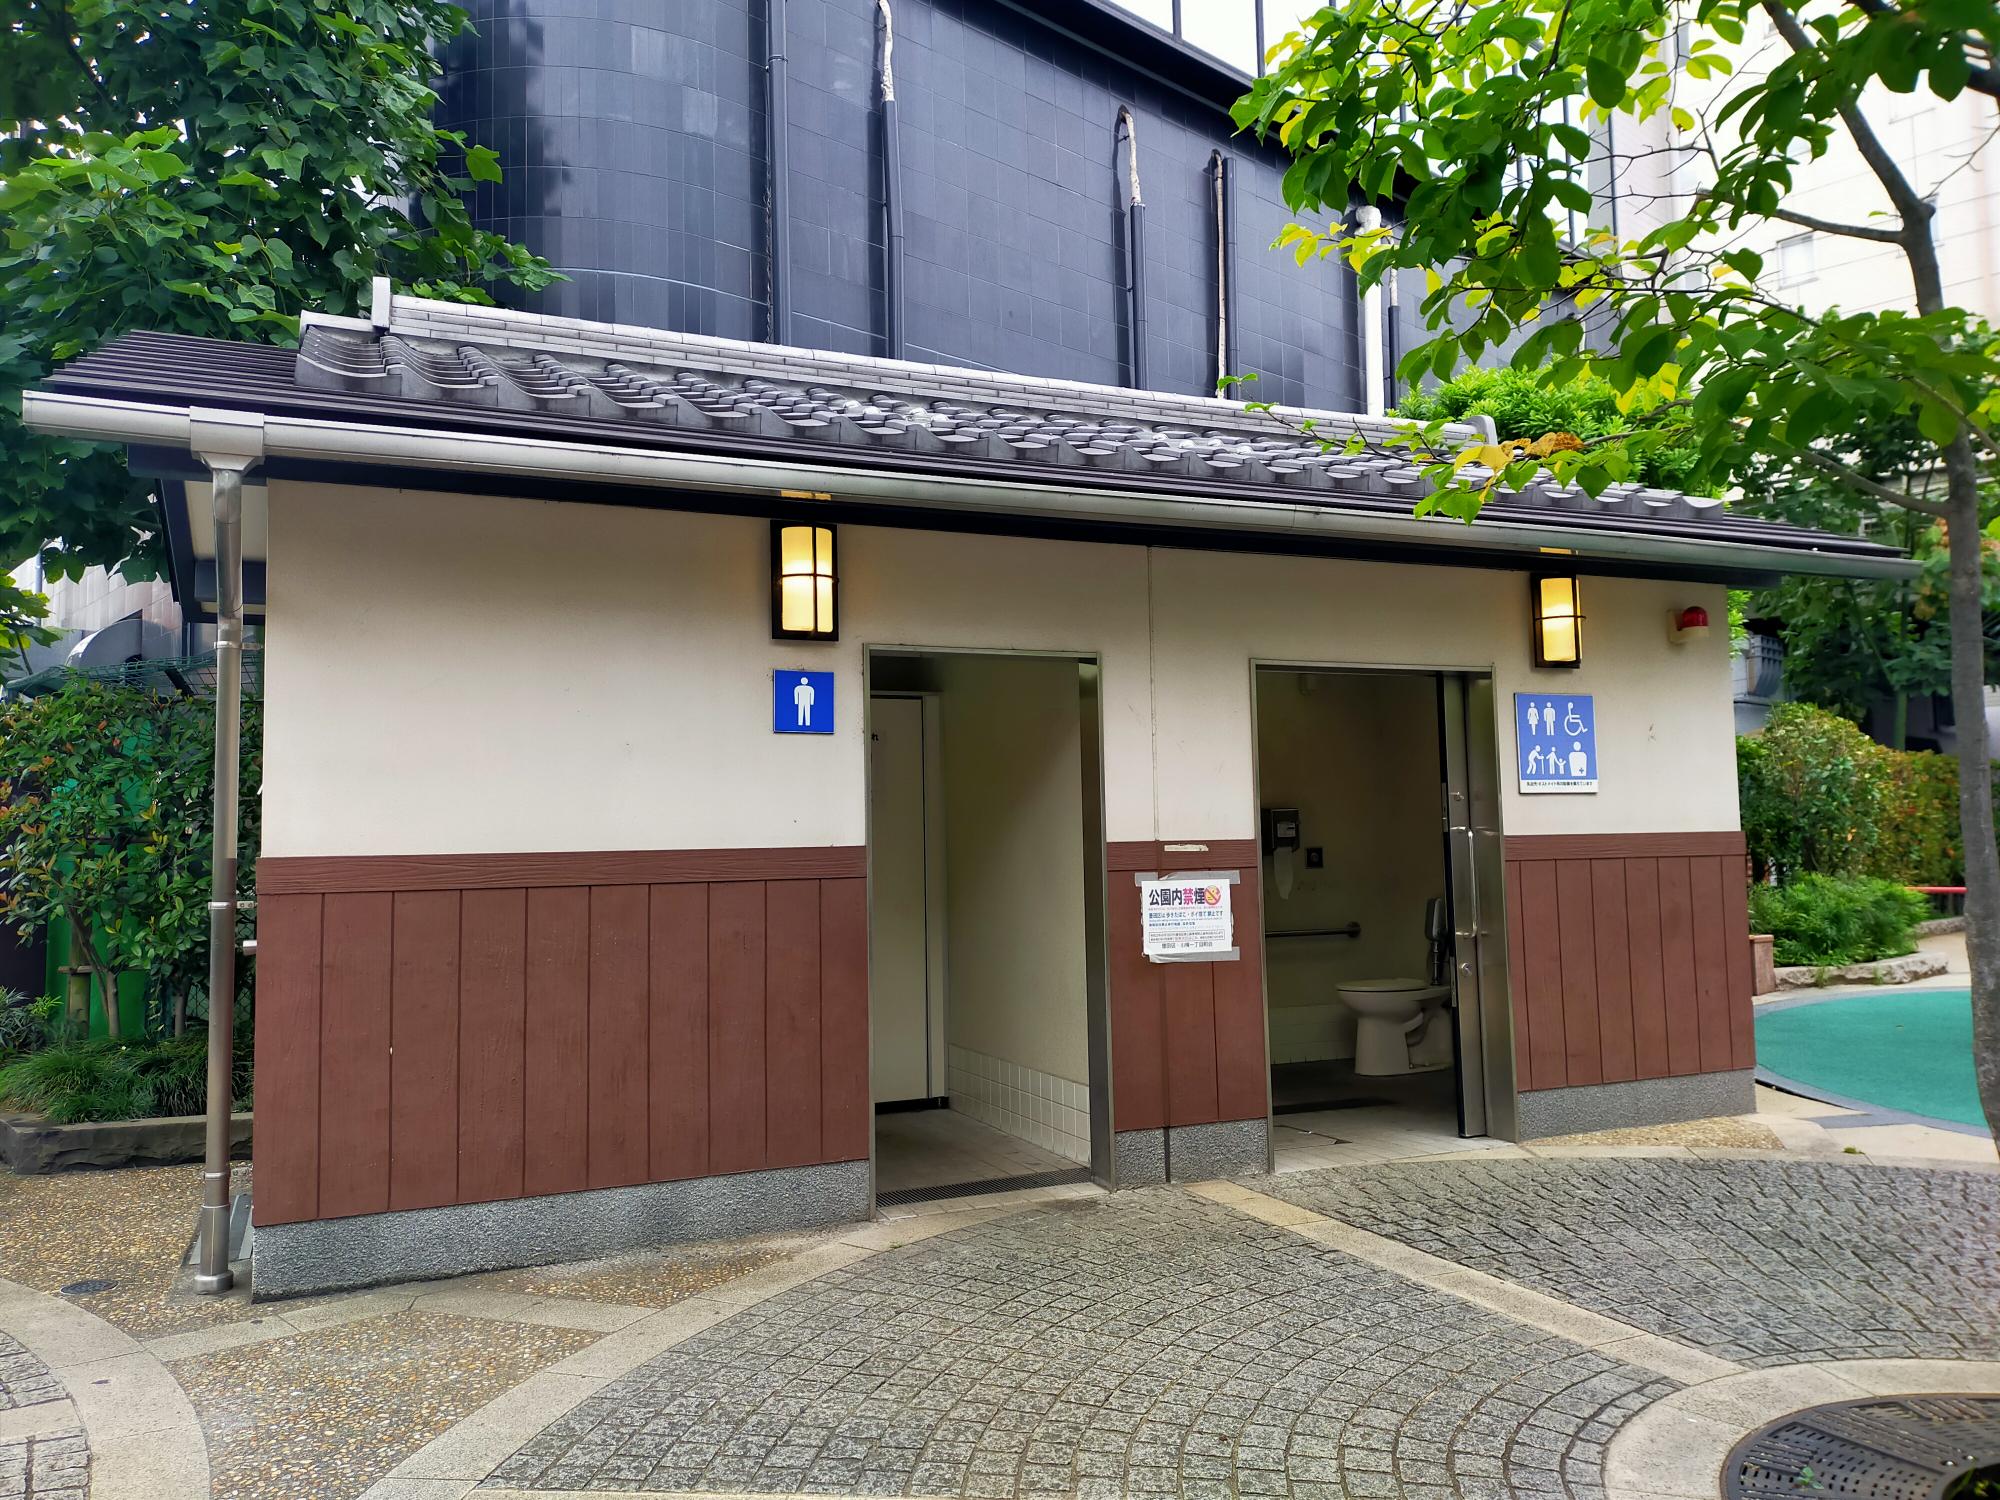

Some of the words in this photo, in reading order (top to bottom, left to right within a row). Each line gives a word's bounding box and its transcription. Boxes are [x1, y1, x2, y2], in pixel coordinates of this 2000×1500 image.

[1149, 888, 1205, 906] 公園内禁煙
